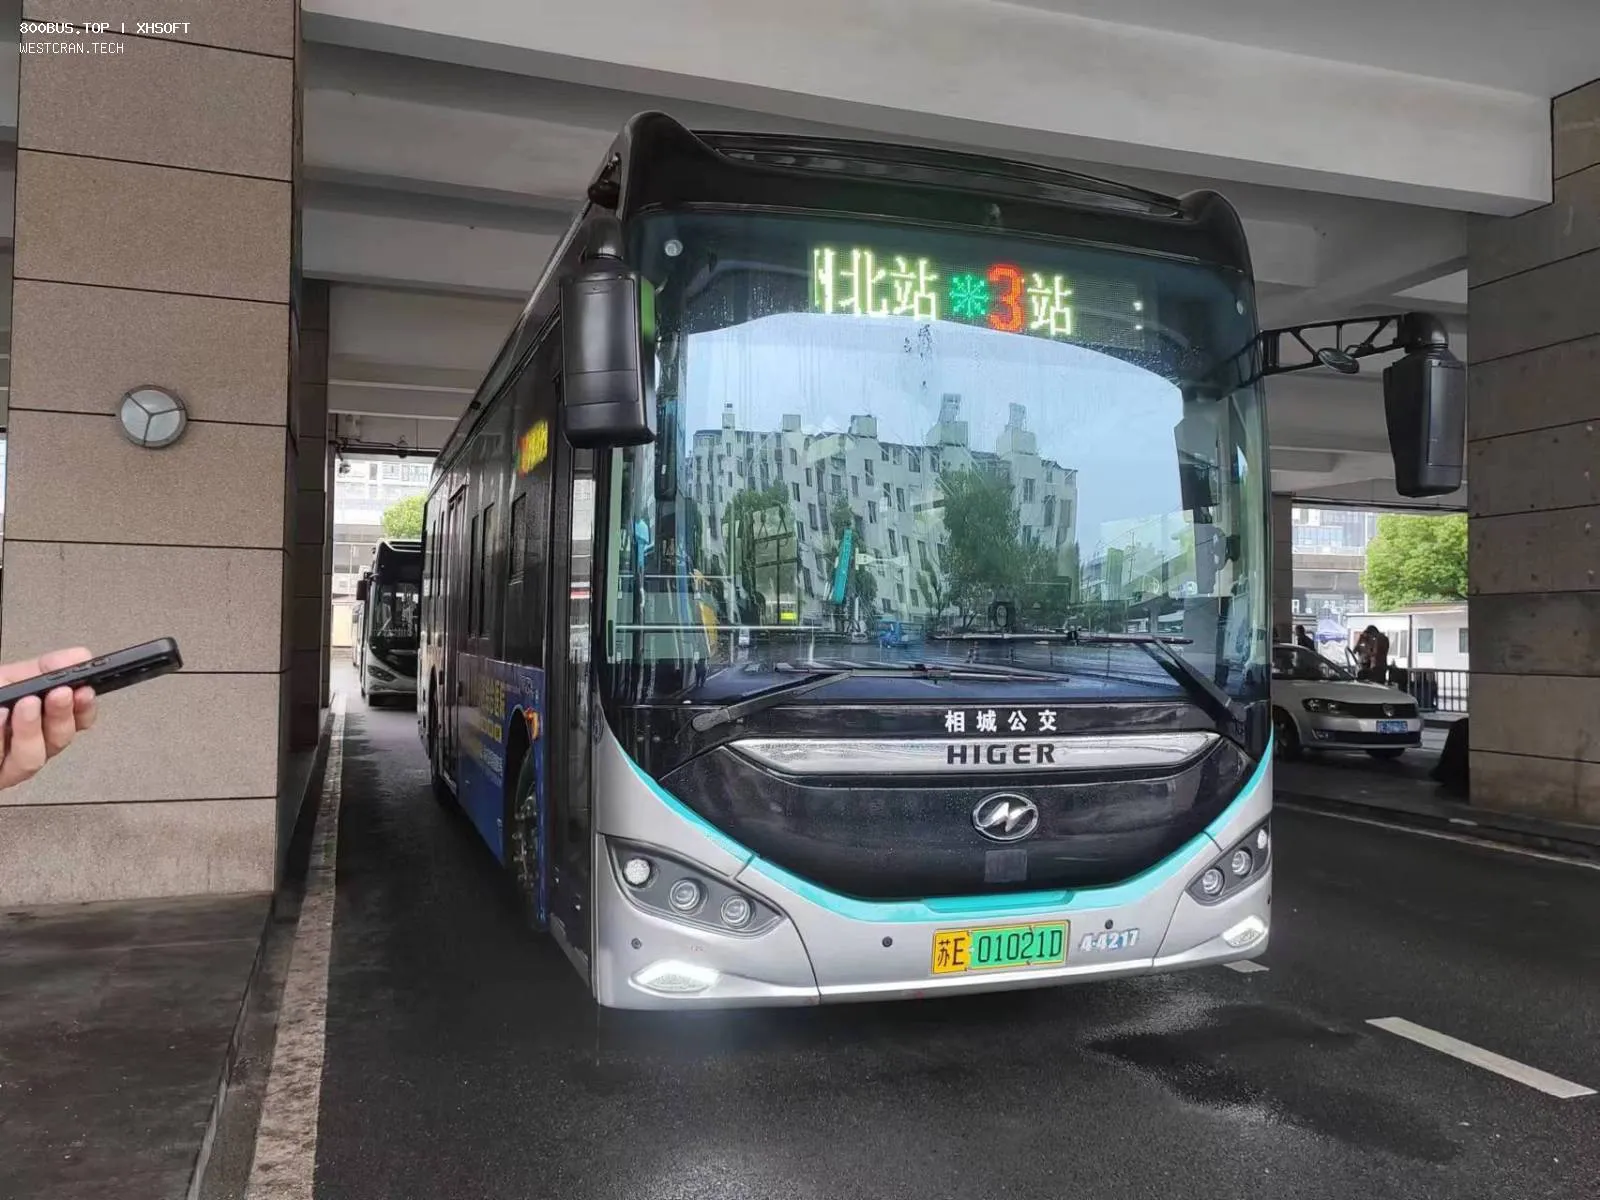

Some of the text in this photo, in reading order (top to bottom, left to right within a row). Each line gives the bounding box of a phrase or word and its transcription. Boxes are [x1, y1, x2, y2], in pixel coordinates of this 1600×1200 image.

[944, 709, 1057, 733] 相城公交
[947, 743, 1056, 765] HIGER
